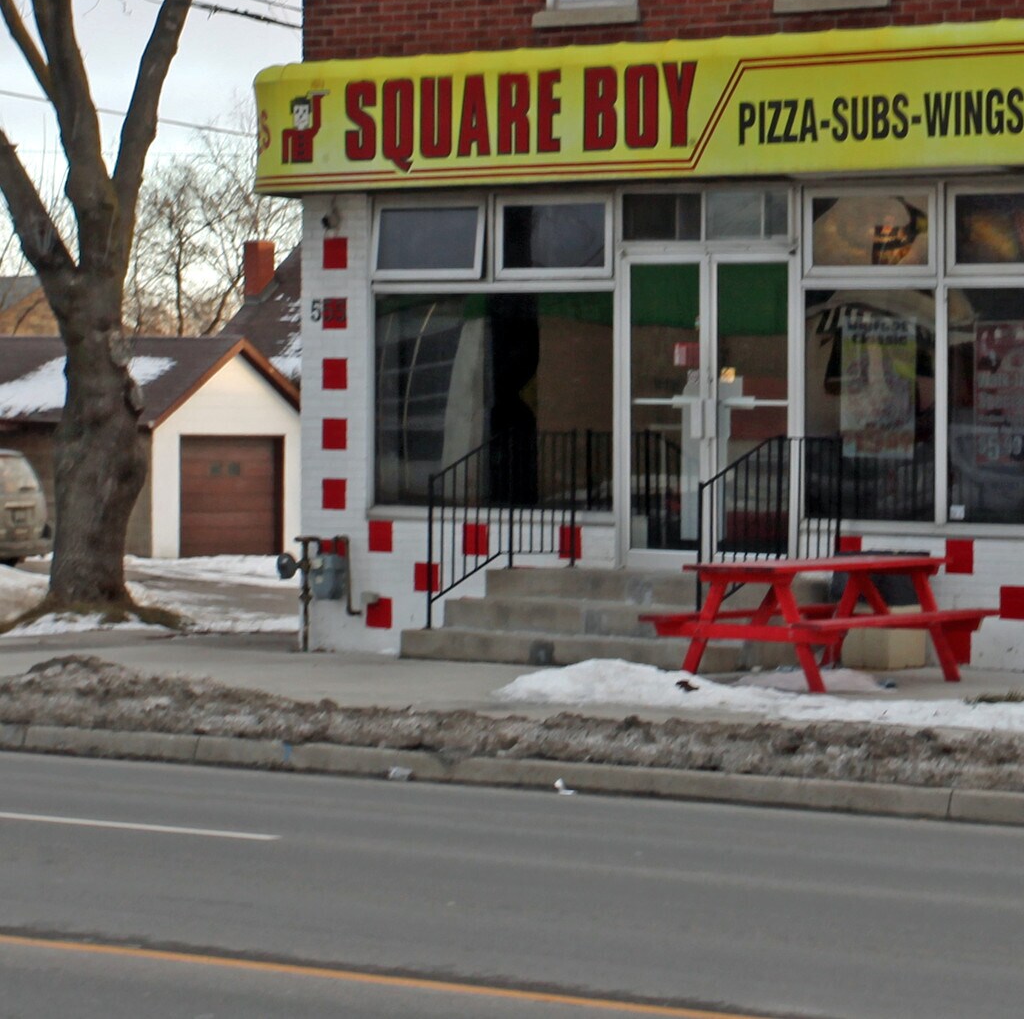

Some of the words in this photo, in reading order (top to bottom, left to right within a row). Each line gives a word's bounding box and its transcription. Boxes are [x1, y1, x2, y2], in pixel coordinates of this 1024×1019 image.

[344, 67, 562, 173] SQUARE
[582, 60, 698, 152] BOY
[738, 87, 1024, 146] PIZZA-SUBS-WINGS
